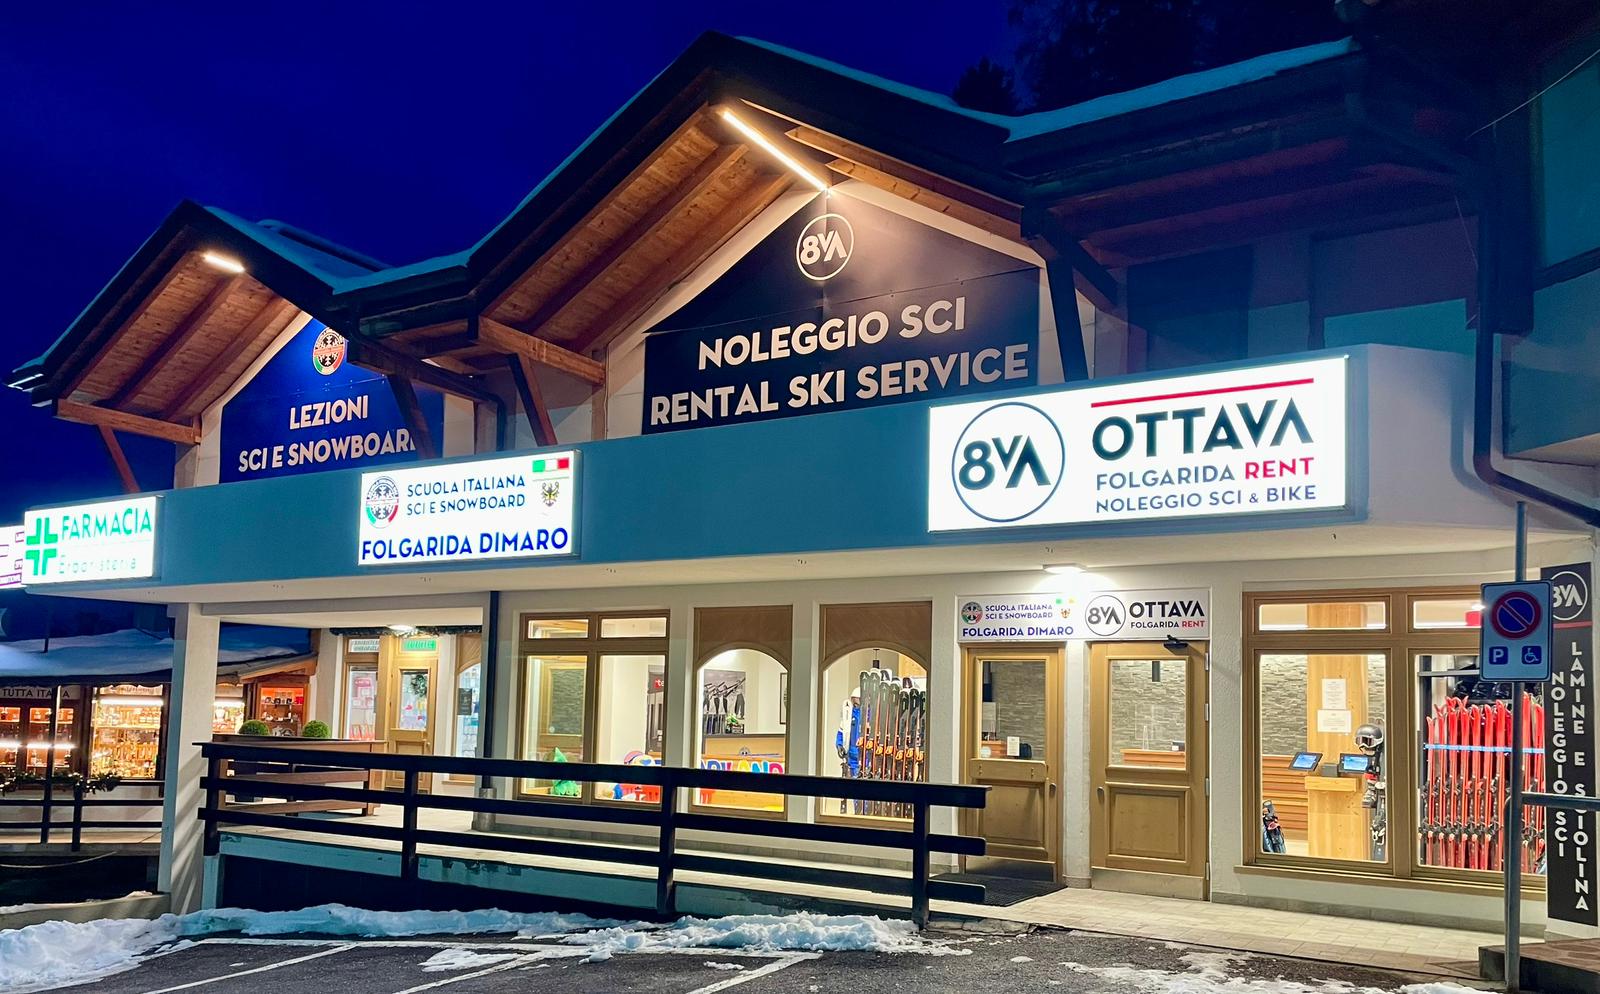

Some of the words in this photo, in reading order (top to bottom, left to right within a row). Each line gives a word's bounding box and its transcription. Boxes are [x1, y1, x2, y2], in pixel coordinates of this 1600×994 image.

[800, 230, 848, 265] 8VA
[698, 311, 889, 370] NOLEGGIO
[899, 297, 966, 338] SCI
[650, 380, 779, 426] RENTAL
[787, 370, 846, 408] SKI
[855, 343, 1030, 399] SERVICE
[289, 395, 369, 430] LEZIONI
[1091, 396, 1314, 462] OTTAVA
[238, 448, 267, 473] SCI
[272, 445, 285, 468] E
[958, 434, 1052, 492] 8VA
[1096, 463, 1236, 491] FOLGARIDA
[1245, 456, 1315, 481] RENT
[407, 481, 459, 497] SCUOLA
[463, 474, 526, 492] ITALIANA
[1096, 493, 1202, 514] NOLEGGIO
[1209, 490, 1242, 506] SCI
[1248, 494, 1259, 504] &
[1266, 484, 1317, 503] BIKE
[406, 502, 426, 516] SCI
[430, 501, 436, 513] E
[440, 493, 526, 513] SNOWBOARD
[61, 507, 152, 540] FARMACIA
[362, 535, 473, 560] FOLGARIDA
[479, 527, 569, 554] DIMARO
[1087, 606, 1122, 625] 8VA
[1129, 600, 1205, 619] OTTAVA
[1131, 620, 1180, 629] FOLGARIDA
[1182, 620, 1206, 628] RENT
[963, 627, 1024, 637] FOLGARIDA
[1027, 626, 1074, 636] DIMARO
[1493, 649, 1505, 663] P
[3, 688, 33, 697] TUTTA
[37, 689, 70, 698] ITAA
[1570, 641, 1586, 734] LAMINE
[1551, 671, 1568, 794] NOLEGGIO
[1574, 751, 1586, 766] E
[1554, 811, 1568, 857] SCI
[1573, 783, 1589, 911] SIOLINA
